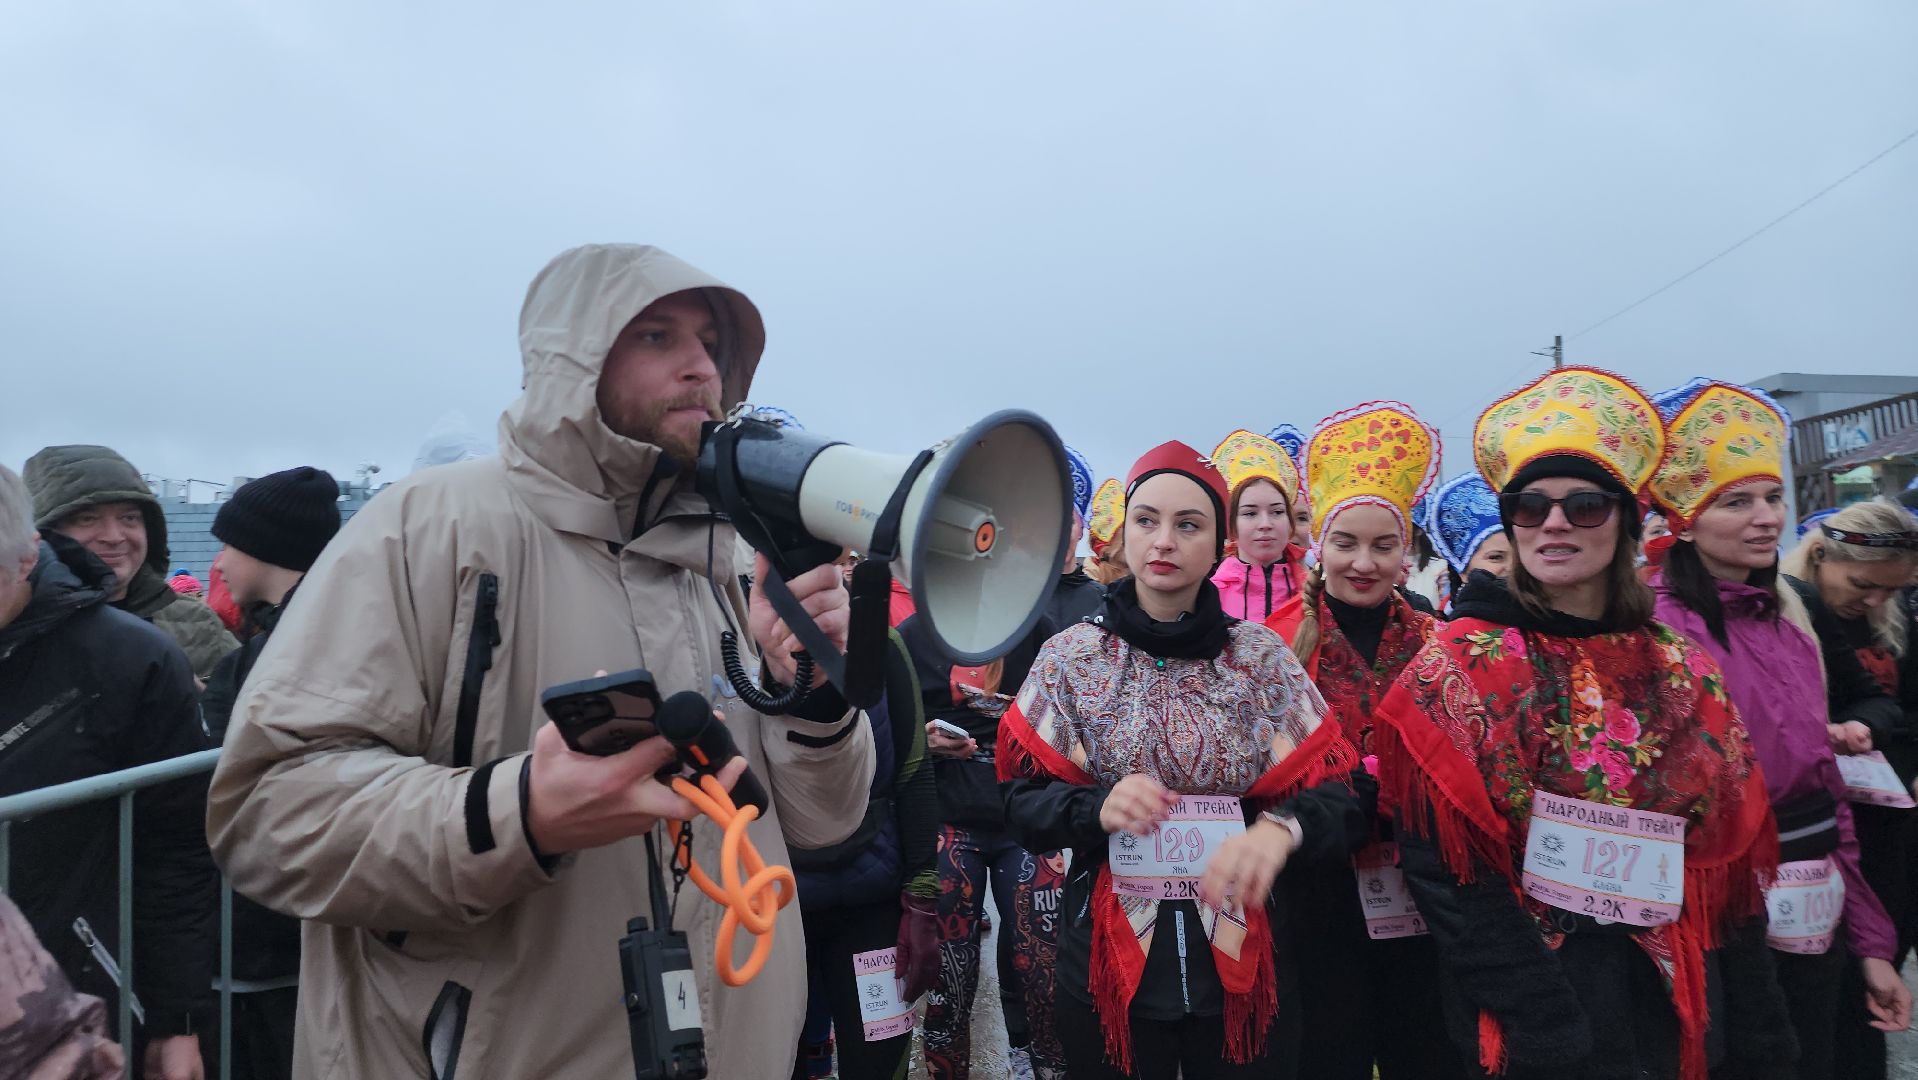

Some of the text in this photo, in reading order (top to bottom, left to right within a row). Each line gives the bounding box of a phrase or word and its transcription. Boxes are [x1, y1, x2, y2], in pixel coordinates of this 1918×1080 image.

[1152, 826, 1205, 862] 129
[1582, 837, 1642, 882] 127
[1172, 866, 1189, 874] ЯНА
[678, 980, 686, 1010] 4
